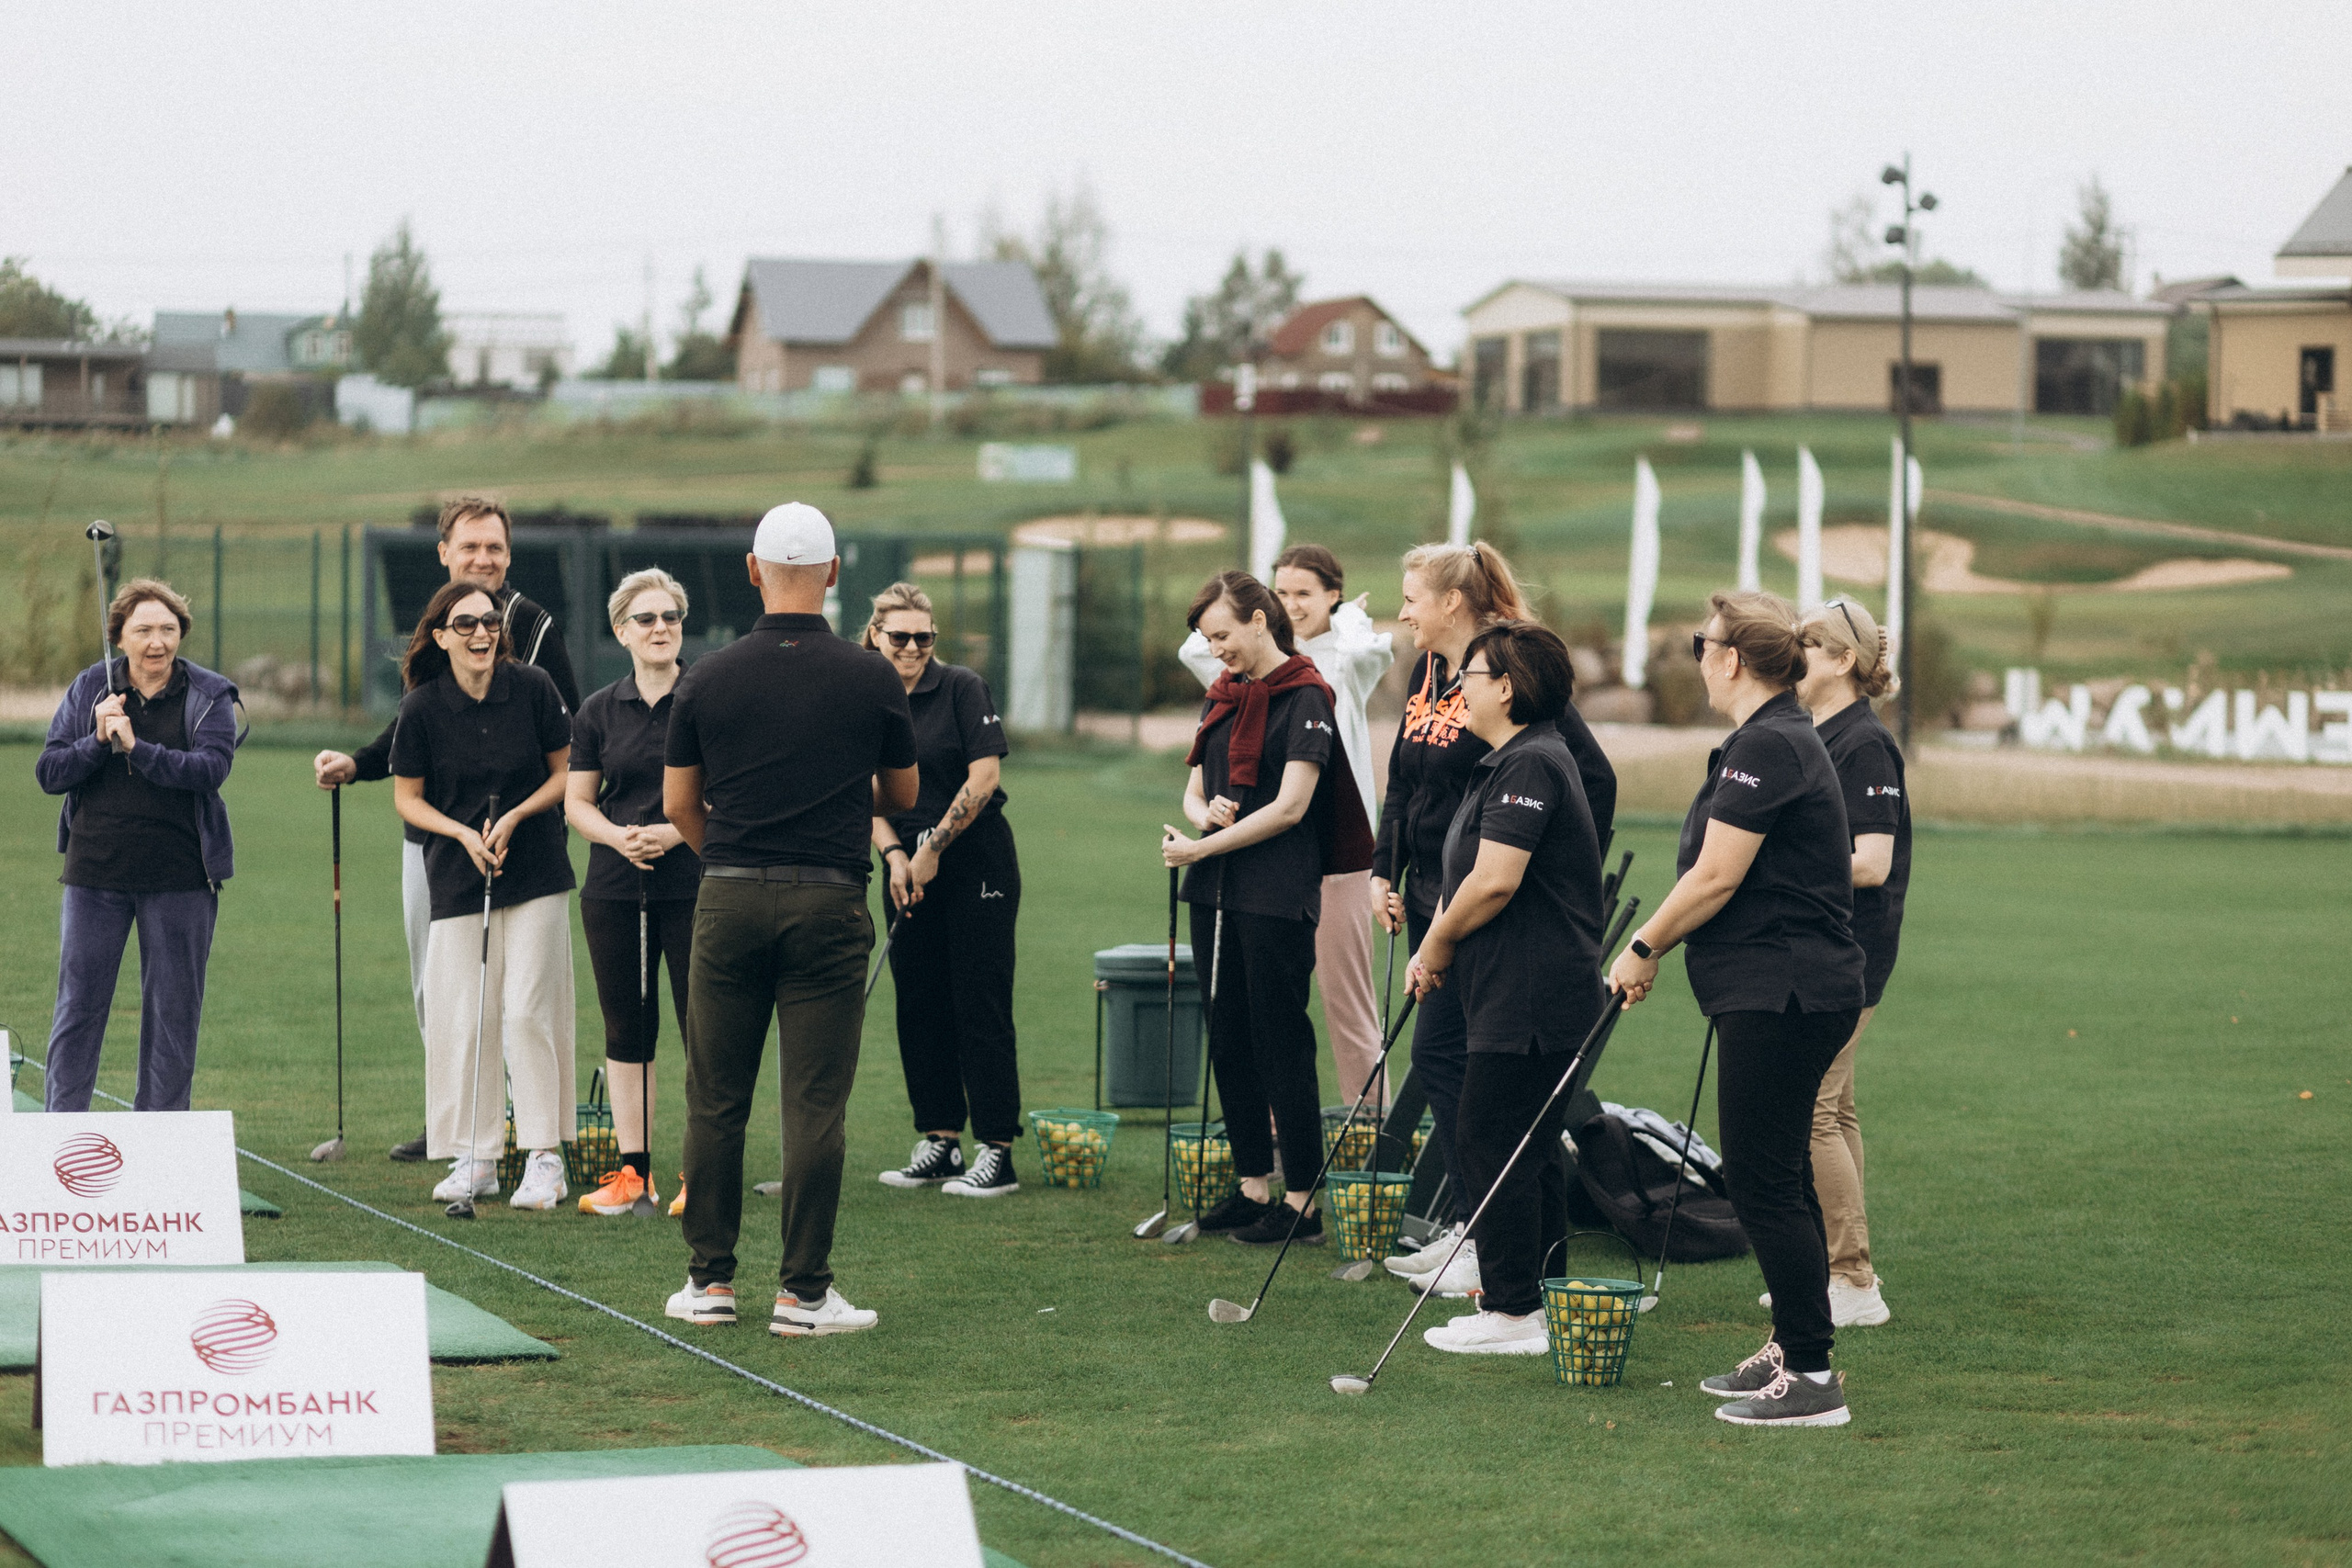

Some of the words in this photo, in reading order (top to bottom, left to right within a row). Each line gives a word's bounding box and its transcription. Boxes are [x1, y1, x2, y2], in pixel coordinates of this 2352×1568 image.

[1726, 768, 1761, 788] БАЗИС
[1510, 795, 1544, 811] БАЗИС
[18, 1238, 168, 1259] ПРЕМИУМ
[93, 1390, 379, 1416] ГАЗПРОМБАНК
[144, 1421, 333, 1449] ПРЕМИУМ
